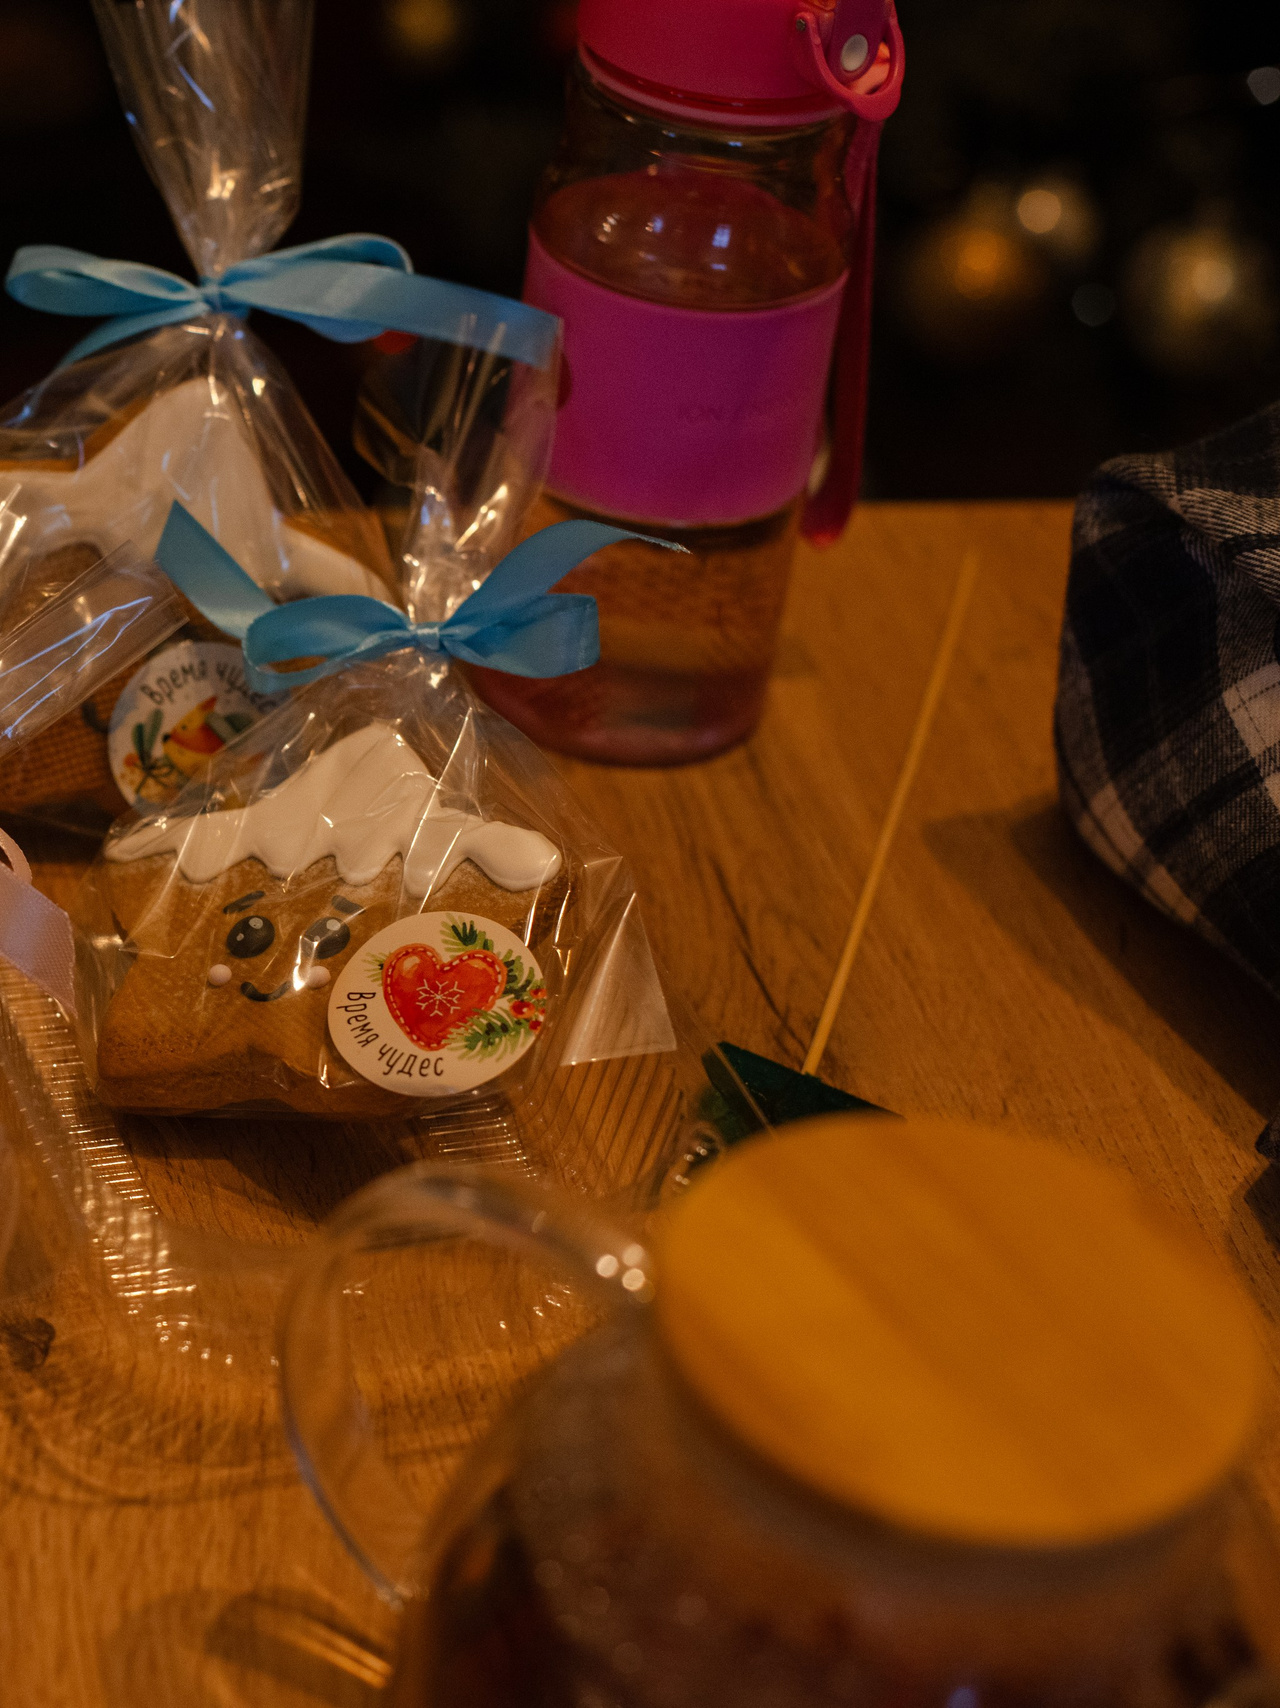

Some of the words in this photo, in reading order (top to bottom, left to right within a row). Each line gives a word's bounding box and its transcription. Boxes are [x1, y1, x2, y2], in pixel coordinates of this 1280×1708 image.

[140, 659, 207, 706] Время
[336, 991, 379, 1048] Время
[378, 1043, 445, 1078] чудес
